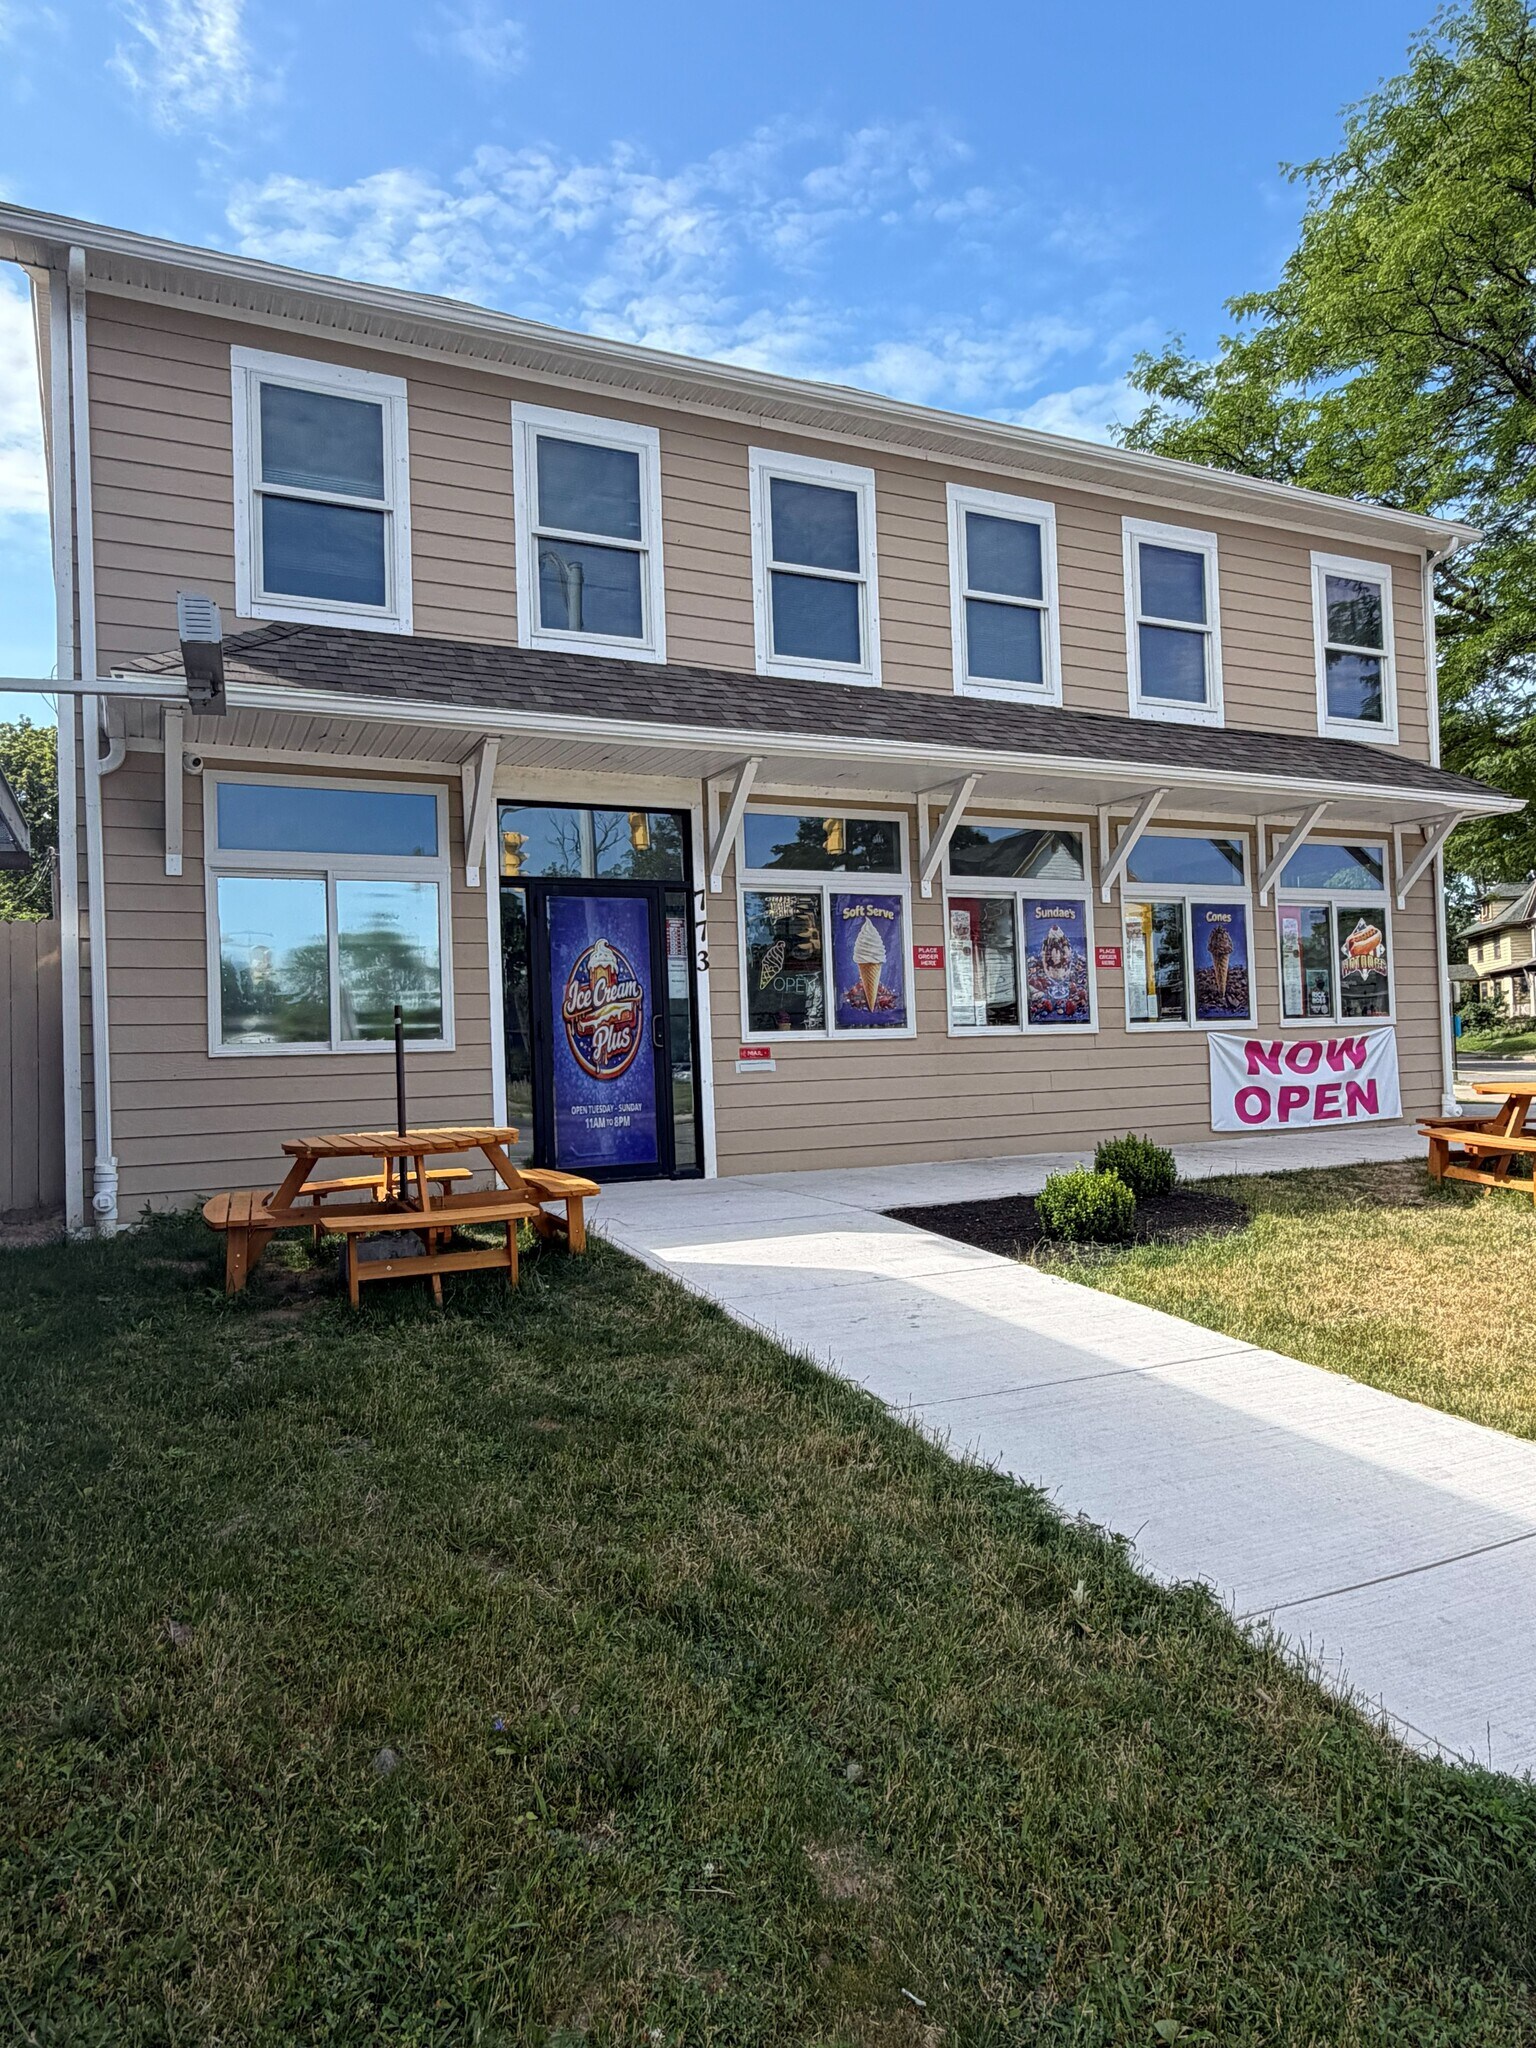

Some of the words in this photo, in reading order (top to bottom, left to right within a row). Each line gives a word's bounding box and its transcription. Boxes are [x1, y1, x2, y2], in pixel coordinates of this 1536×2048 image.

[843, 905, 865, 920] Soft
[866, 905, 895, 920] Serve
[1035, 906, 1076, 919] Sundae's
[1206, 911, 1232, 923] Cones
[773, 977, 816, 993] OPEN
[567, 980, 592, 1012] Ice
[593, 977, 640, 1006] Cream
[592, 1025, 630, 1060] Plus
[1244, 1035, 1370, 1075] NOW
[571, 1105, 587, 1115] OPEN
[588, 1104, 614, 1114] TUESDAY
[618, 1103, 643, 1113] SUNDAY
[1234, 1078, 1380, 1125] OPEN
[585, 1117, 606, 1129] 11AM
[606, 1118, 614, 1126] TO
[614, 1116, 631, 1127] 8PM
